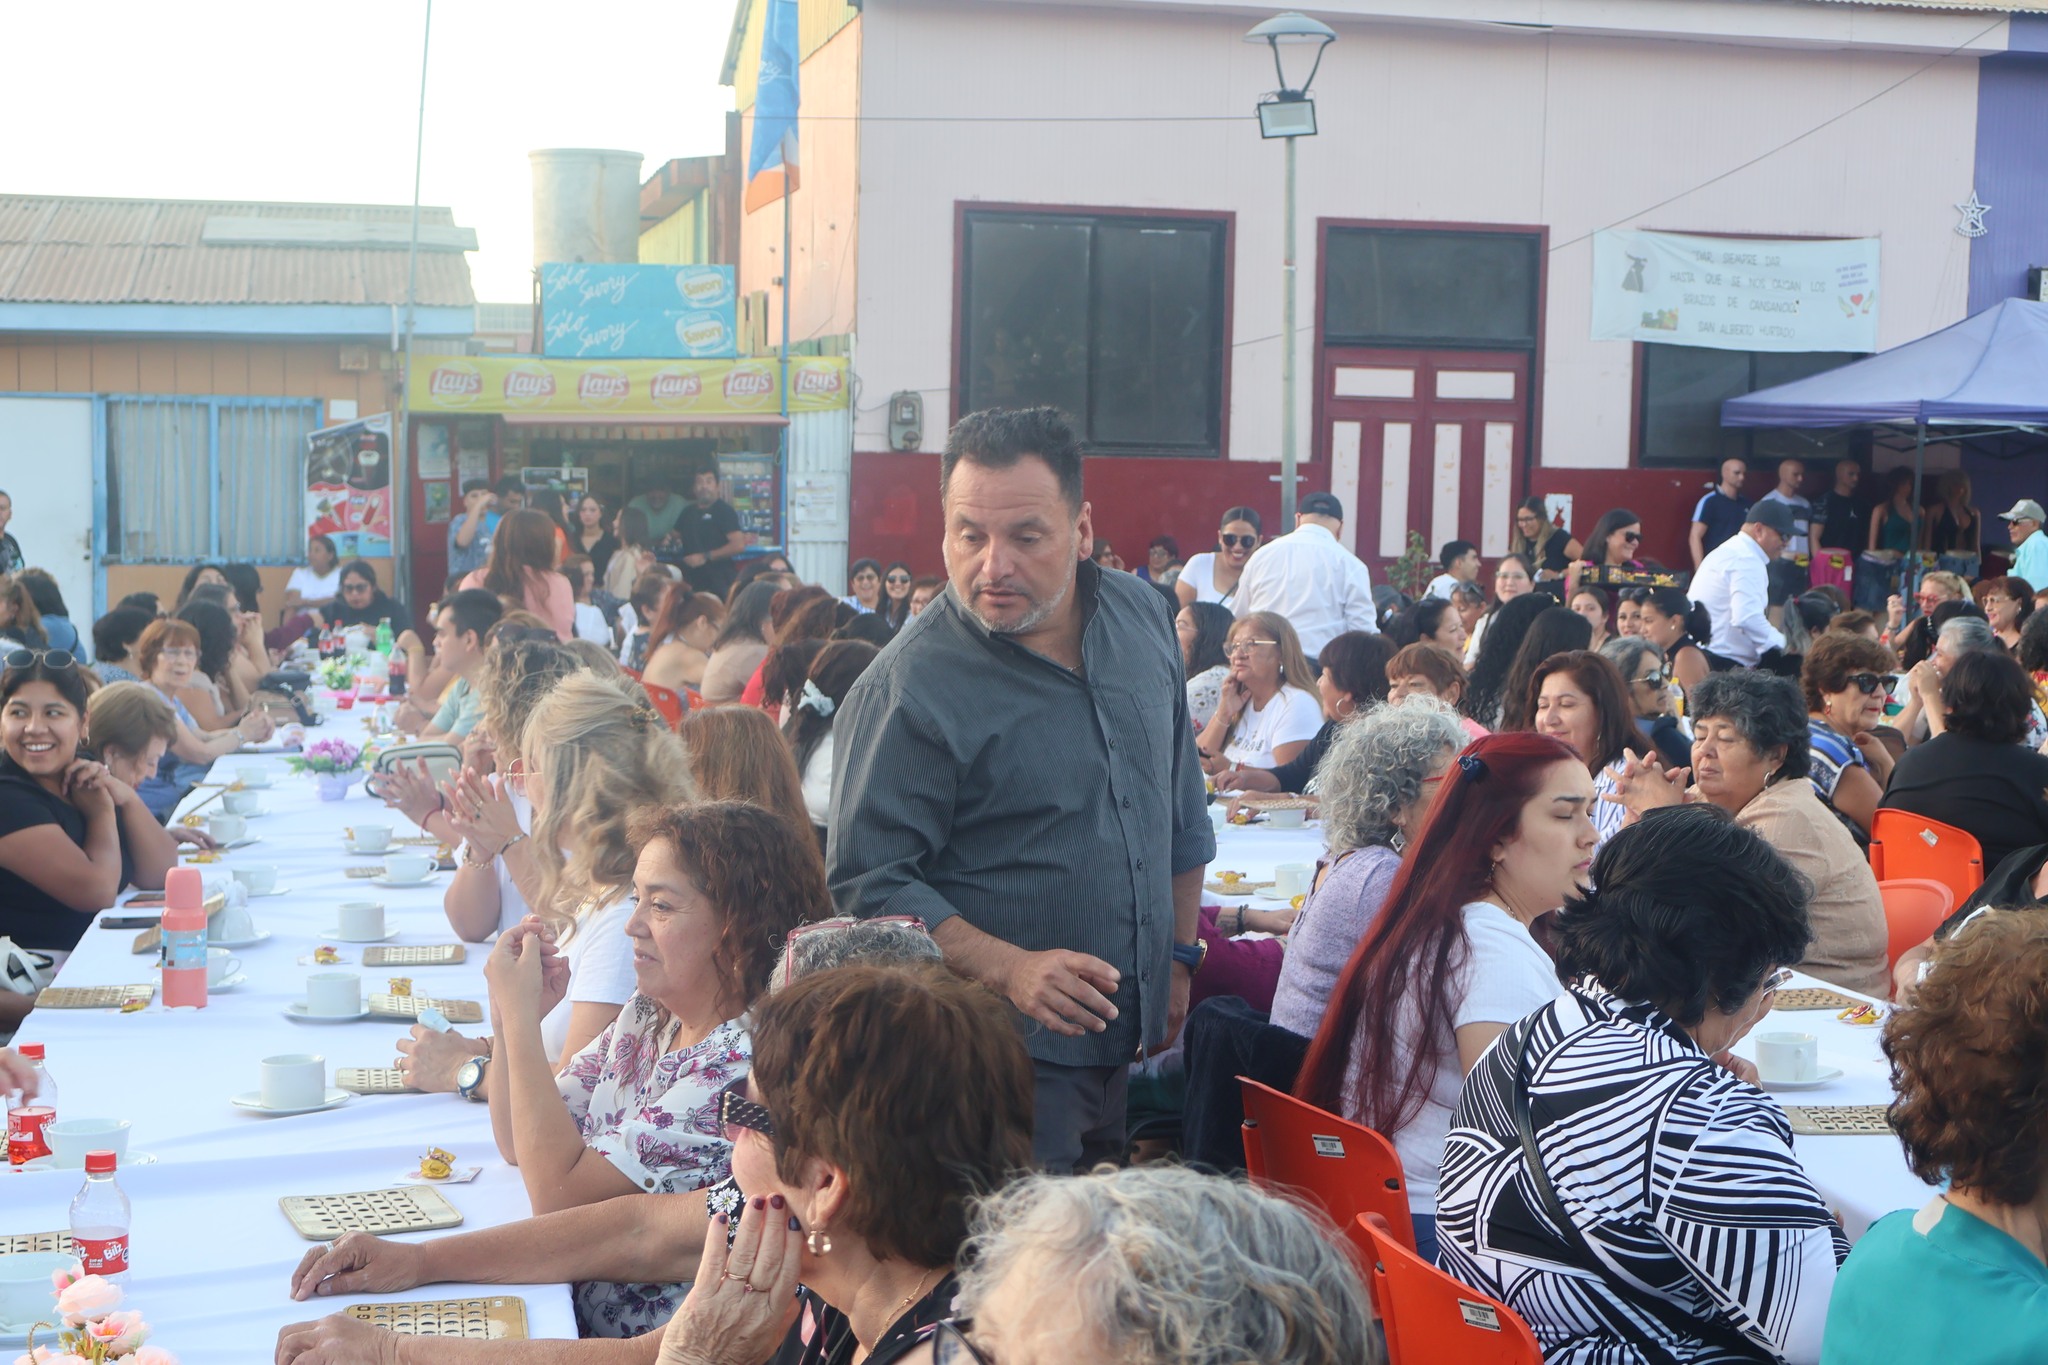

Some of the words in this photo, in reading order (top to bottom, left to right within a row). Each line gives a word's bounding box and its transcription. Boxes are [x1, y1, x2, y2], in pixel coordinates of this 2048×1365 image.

[1765, 255, 1781, 267] DAR
[683, 278, 722, 297] Savory
[1670, 271, 1695, 284] HASTA
[1705, 272, 1722, 286] QUE
[1731, 275, 1741, 288] SE
[1749, 277, 1766, 290] NOS
[1810, 281, 1825, 293] LOS
[1683, 293, 1716, 306] BRAZOS
[1727, 296, 1738, 308] DE
[683, 325, 722, 345] Savory
[1698, 320, 1715, 333] SAN
[1720, 323, 1754, 337] ALBERTO
[103, 1243, 123, 1260] Bilz
